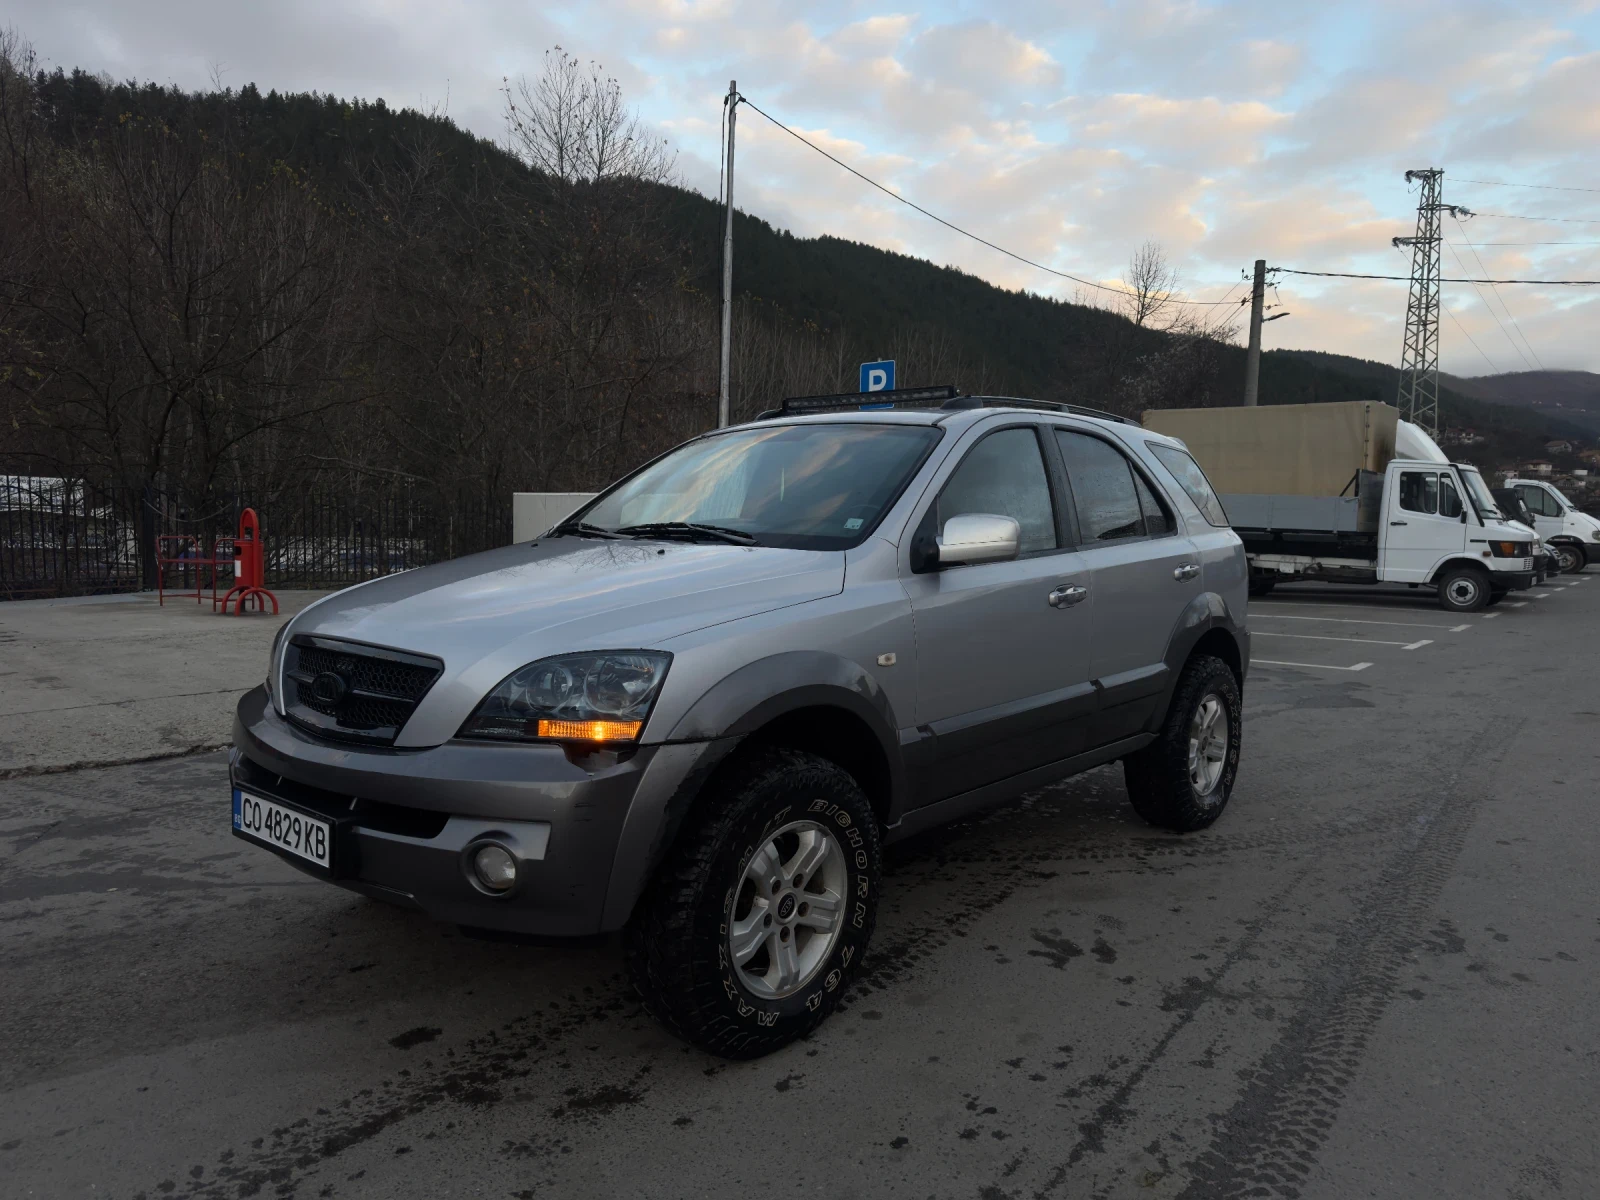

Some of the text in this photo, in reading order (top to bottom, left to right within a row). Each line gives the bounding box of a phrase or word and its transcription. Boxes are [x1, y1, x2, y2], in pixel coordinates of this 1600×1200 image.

[868, 369, 887, 392] P
[805, 798, 869, 1012] BIGHORN 764
